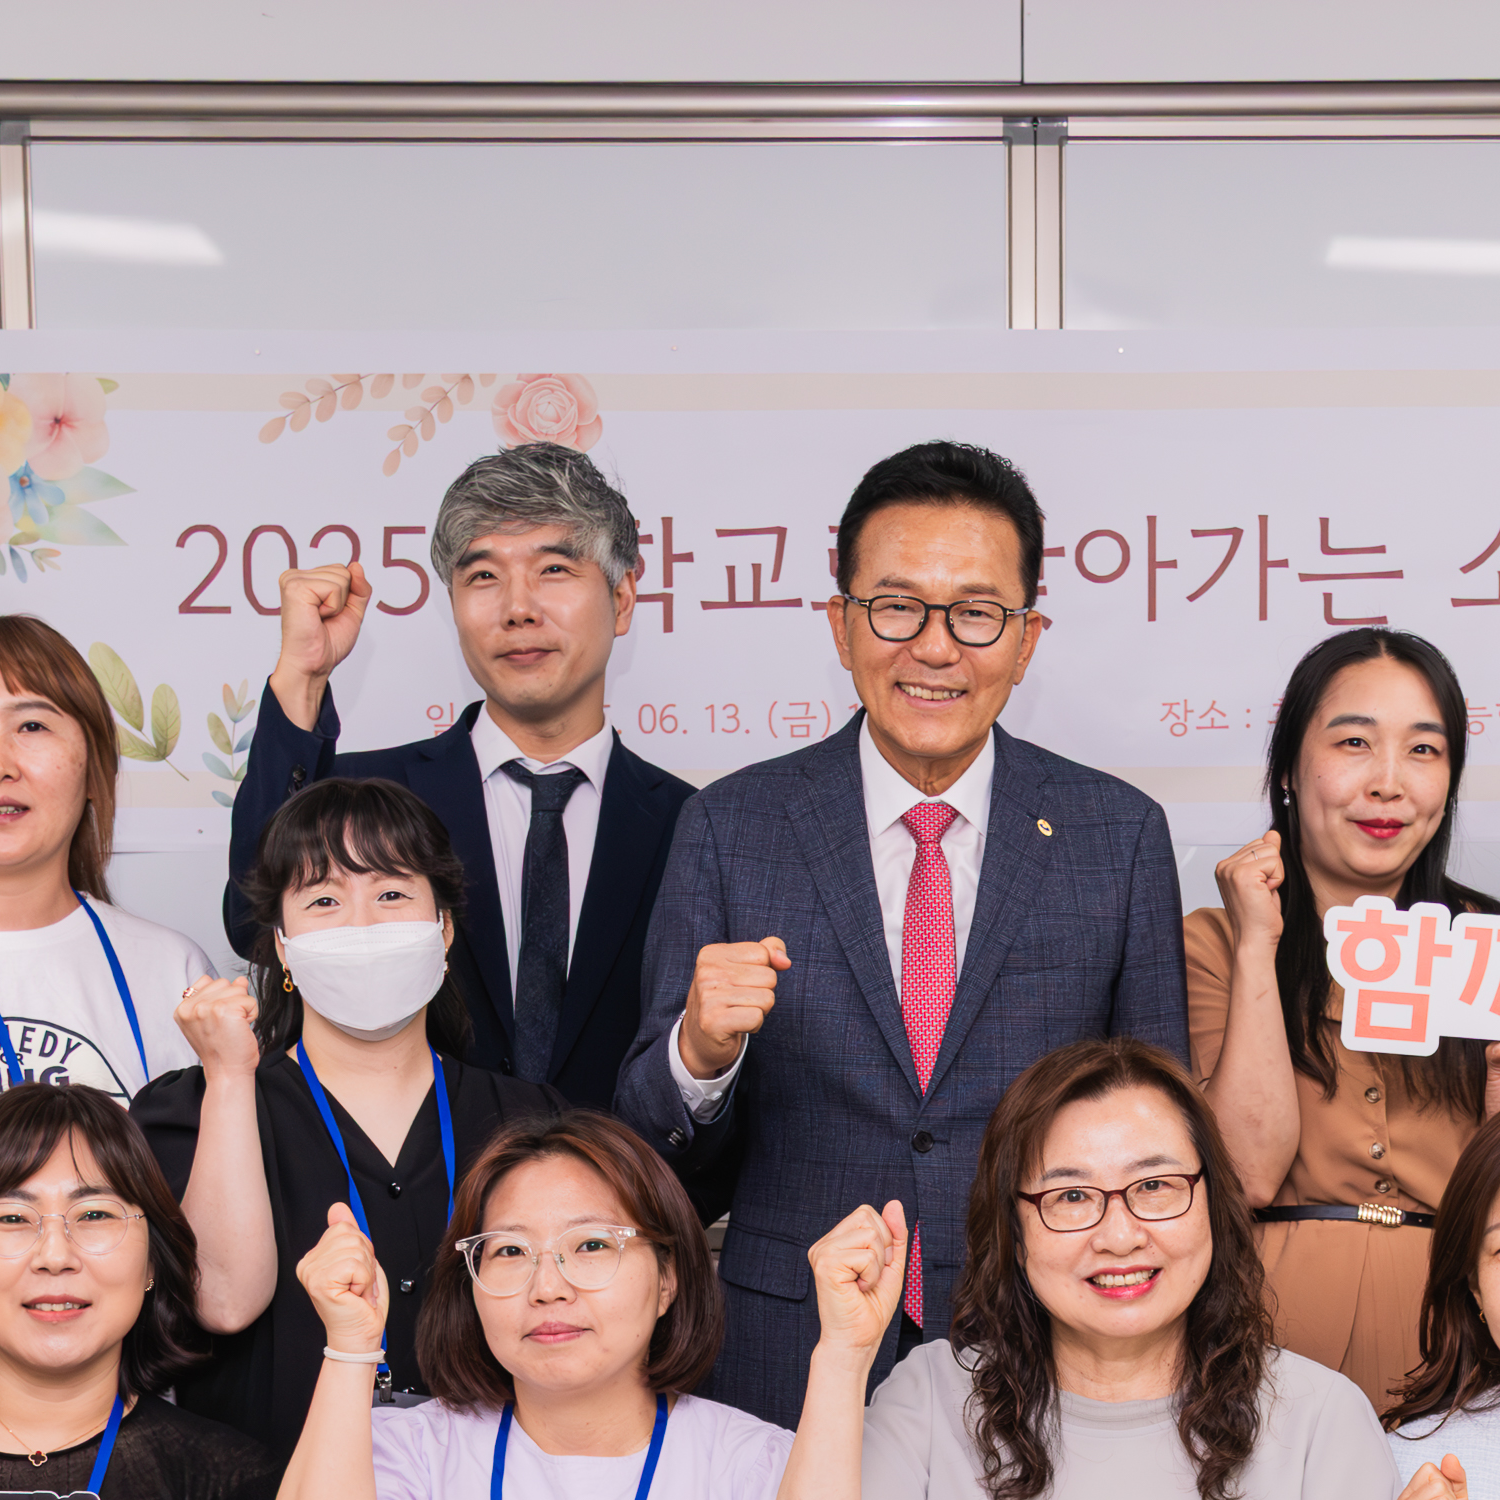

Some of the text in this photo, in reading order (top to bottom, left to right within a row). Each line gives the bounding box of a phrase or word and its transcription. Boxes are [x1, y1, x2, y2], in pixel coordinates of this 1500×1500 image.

[1037, 514, 1404, 630] 아가는
[638, 703, 688, 735] 06.
[704, 703, 751, 735] 13.
[767, 700, 832, 739] (금)
